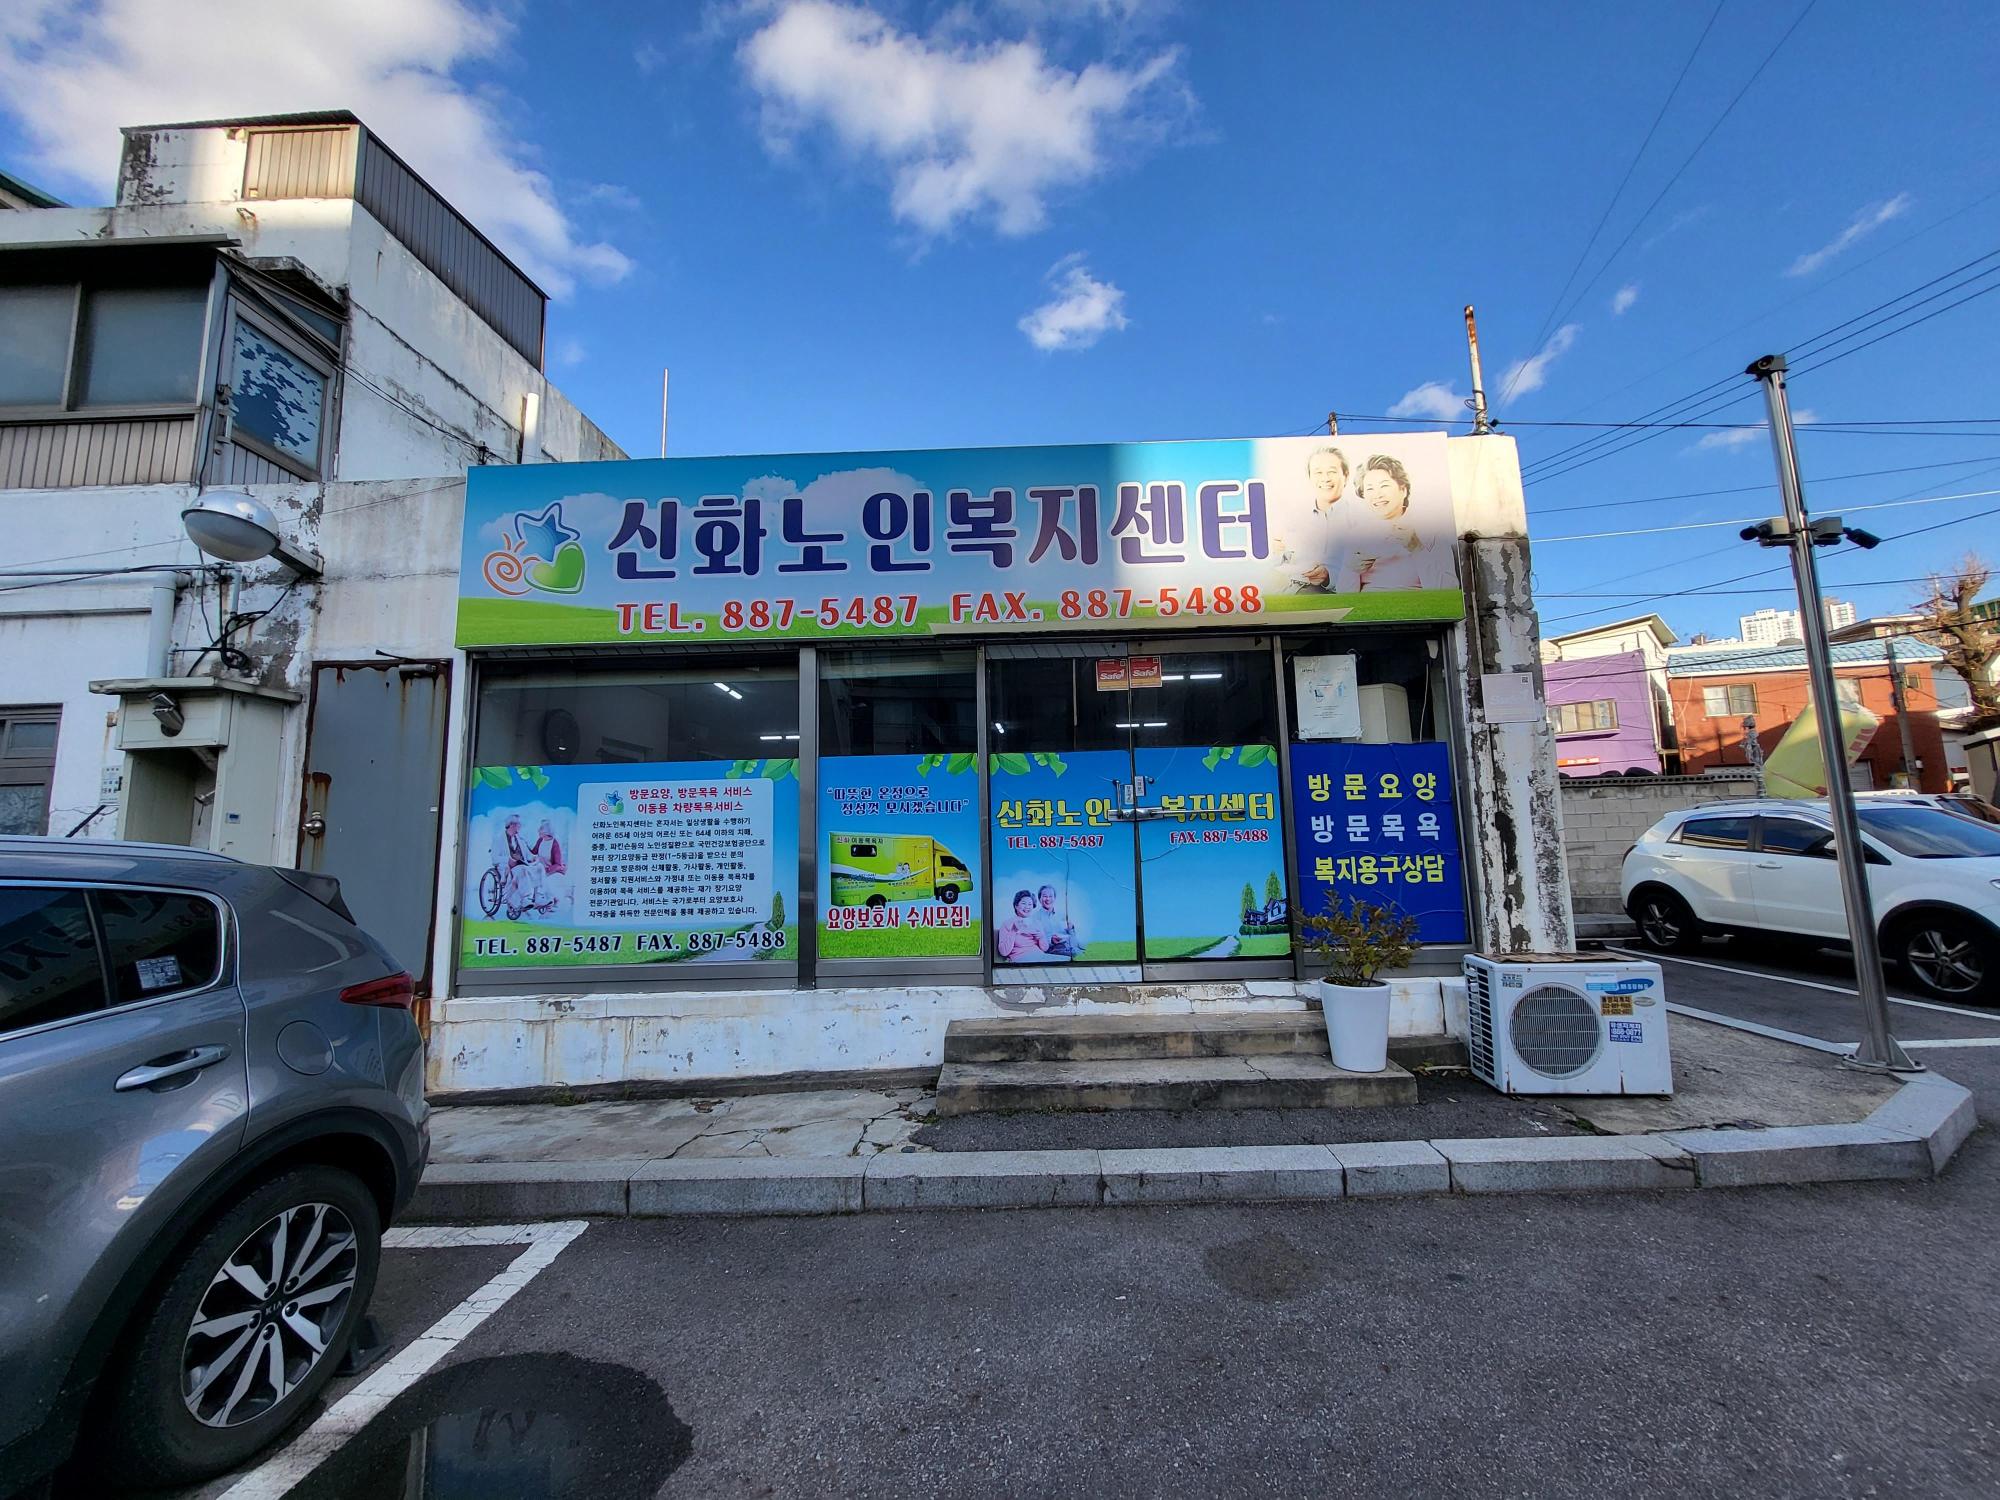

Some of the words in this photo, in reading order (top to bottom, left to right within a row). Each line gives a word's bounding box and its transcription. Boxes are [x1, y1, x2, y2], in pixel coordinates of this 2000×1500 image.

[607, 480, 1271, 580] 신화노인복지센터
[616, 603, 703, 632] TEL.
[723, 595, 919, 629] 887-5487
[951, 591, 1041, 622] FAX.
[1059, 585, 1263, 618] 887-5488
[630, 788, 673, 800] 방문요양,
[678, 787, 718, 798] 방문목욕
[723, 787, 752, 797] 서비스
[878, 786, 929, 800] 온정으로
[638, 804, 668, 814] 이동용
[673, 802, 743, 813] 차량목욕서비스
[842, 802, 879, 816] 정성껏
[996, 798, 1112, 828] 신화노인
[1161, 792, 1275, 823] 복지센터
[592, 821, 653, 829] 신화노인복지센터는
[687, 818, 719, 826] 일상생활을
[723, 817, 750, 825] 수행하기
[592, 832, 611, 840] 어려운
[615, 831, 630, 839] 65세
[656, 830, 676, 838] 어르신
[679, 829, 692, 837] 또는
[714, 828, 734, 836] 이하의
[1007, 835, 1036, 848] TEL.
[1039, 835, 1104, 847] 887-5487
[1170, 831, 1199, 844] FAX.
[1203, 829, 1269, 843] 887-5488
[648, 841, 694, 849] 노인성질환으로
[698, 840, 765, 848] 국민건강보험공단으로
[608, 853, 648, 861] 장기요양등급
[730, 851, 743, 859] 분의
[1314, 854, 1444, 884] 복지용구상담
[621, 875, 661, 883] 지원서비스와
[688, 874, 700, 882] 또는
[728, 873, 755, 881] 목욕차를
[590, 888, 617, 896] 이용하여
[620, 887, 633, 895] 목욕
[637, 886, 663, 894] 서비스를
[715, 884, 742, 892] 장기요양
[672, 897, 706, 905] 국가로부터
[709, 896, 743, 904] 요양보호사
[589, 910, 616, 918] 자격증을
[643, 908, 676, 916] 전문인력을
[697, 907, 724, 915] 제공하고
[728, 906, 757, 914] 있습니다.
[827, 906, 900, 929] 요양보호사
[907, 905, 970, 928] 수시모집!
[476, 939, 517, 954] TEL.
[526, 935, 622, 953] 887-5487
[637, 934, 680, 950] FAX.
[689, 931, 785, 949] 887-5488
[266, 1301, 282, 1315] KIA
